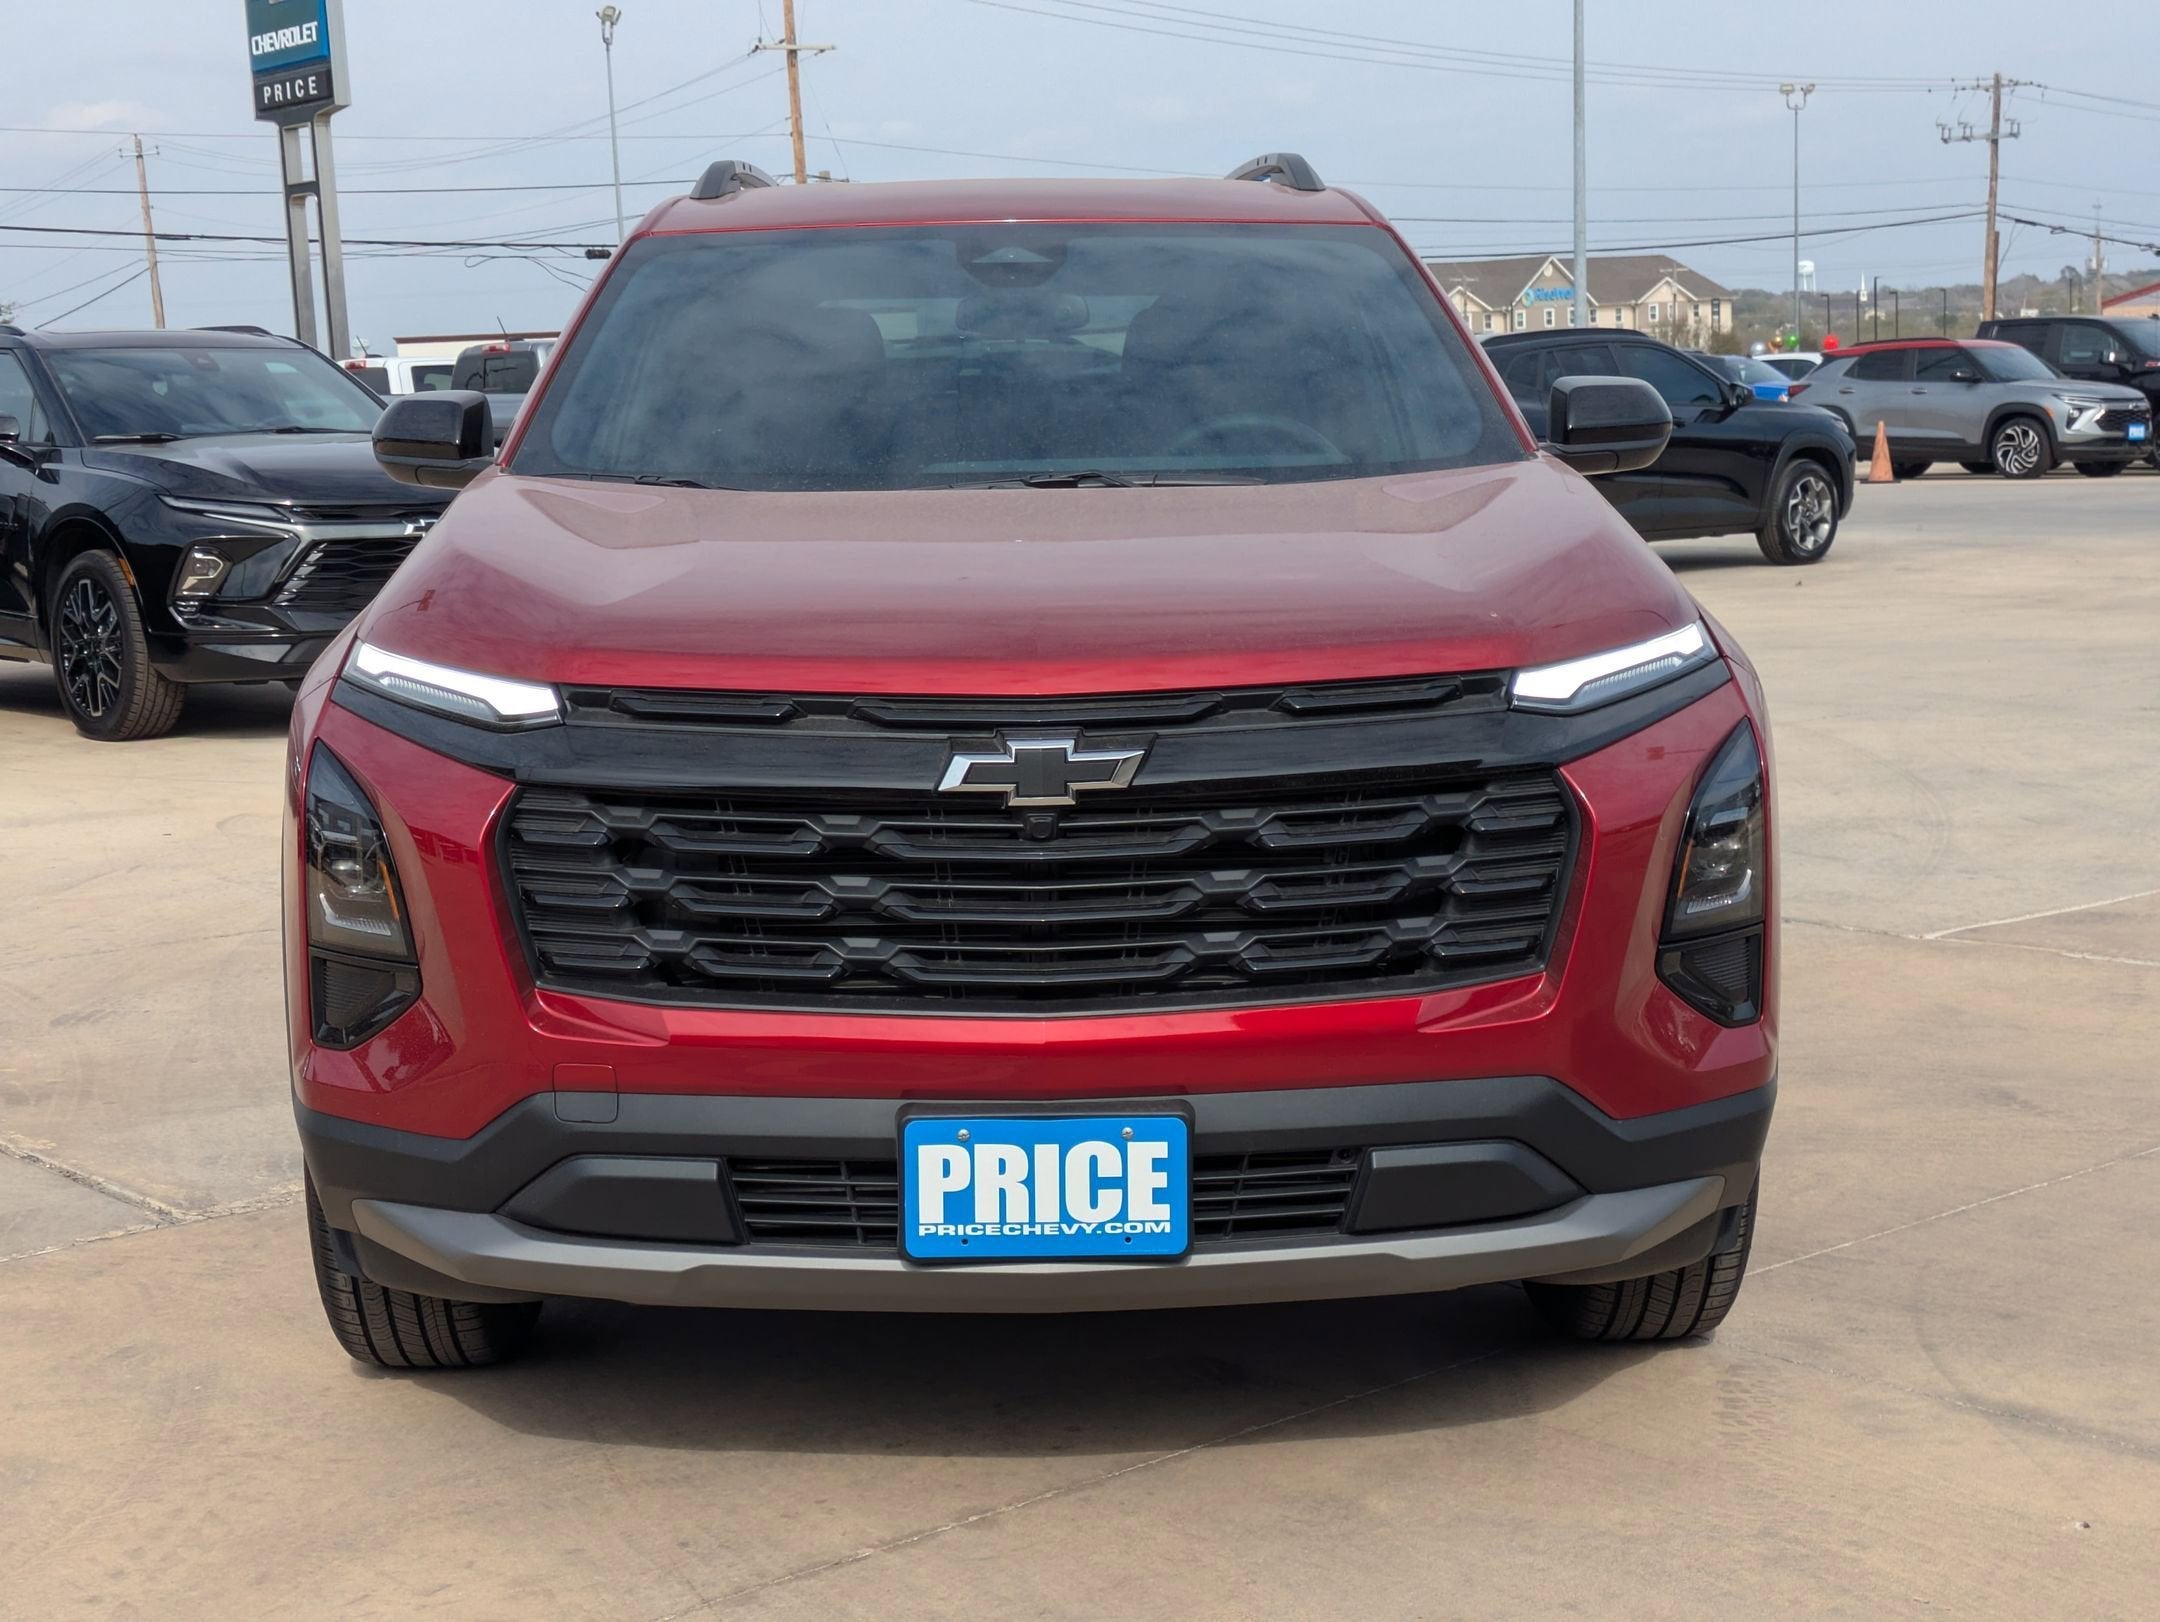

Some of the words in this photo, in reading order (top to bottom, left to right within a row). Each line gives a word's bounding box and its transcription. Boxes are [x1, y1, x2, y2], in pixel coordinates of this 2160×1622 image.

[251, 21, 318, 56] CHEVROLET
[263, 76, 318, 104] PRICE
[917, 1140, 1171, 1224] PRICE
[918, 1221, 1171, 1237] PRICECHEVY.COM
